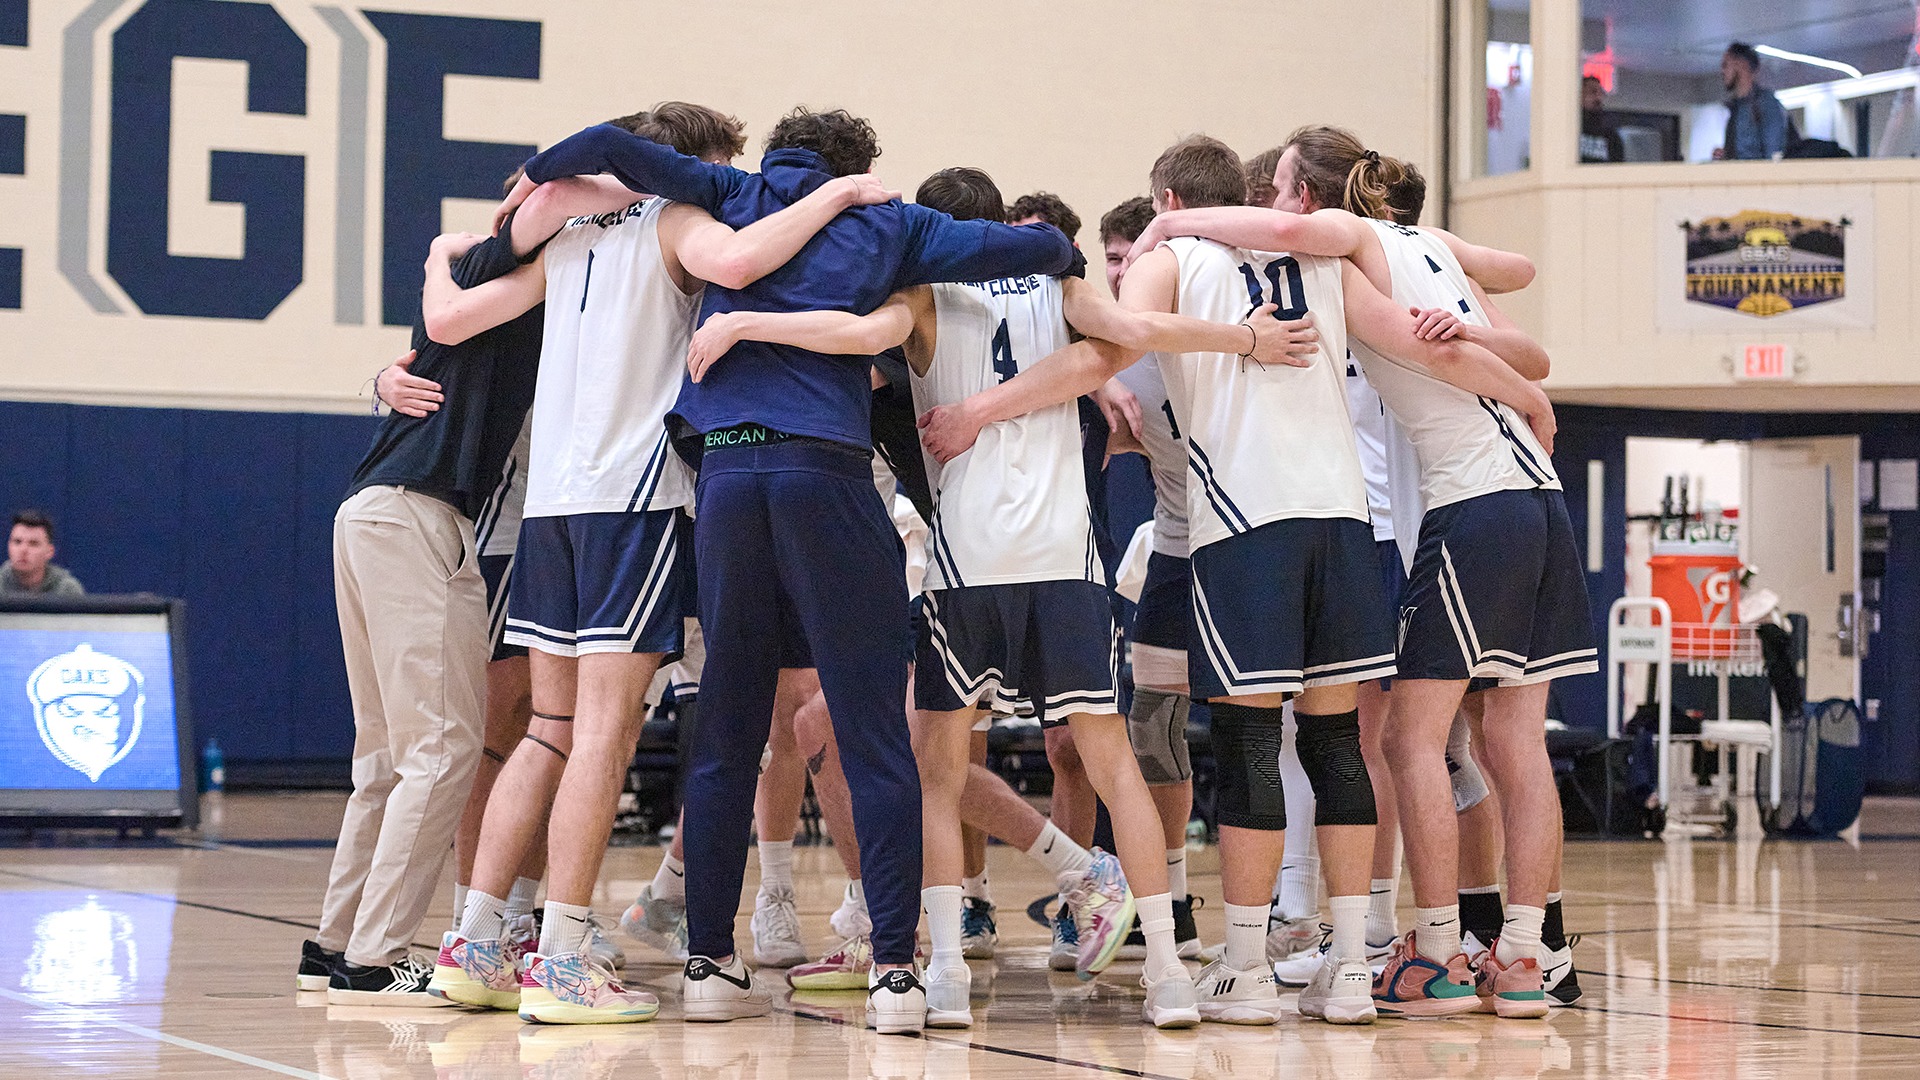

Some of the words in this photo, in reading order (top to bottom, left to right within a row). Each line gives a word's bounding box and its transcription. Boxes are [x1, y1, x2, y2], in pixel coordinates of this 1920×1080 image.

[0, 0, 541, 326] GE
[1238, 256, 1309, 322] 10
[1687, 277, 1842, 298] TOURNAMENT
[991, 317, 1019, 384] 4
[1744, 344, 1785, 378] EXIT
[1706, 571, 1731, 604] G
